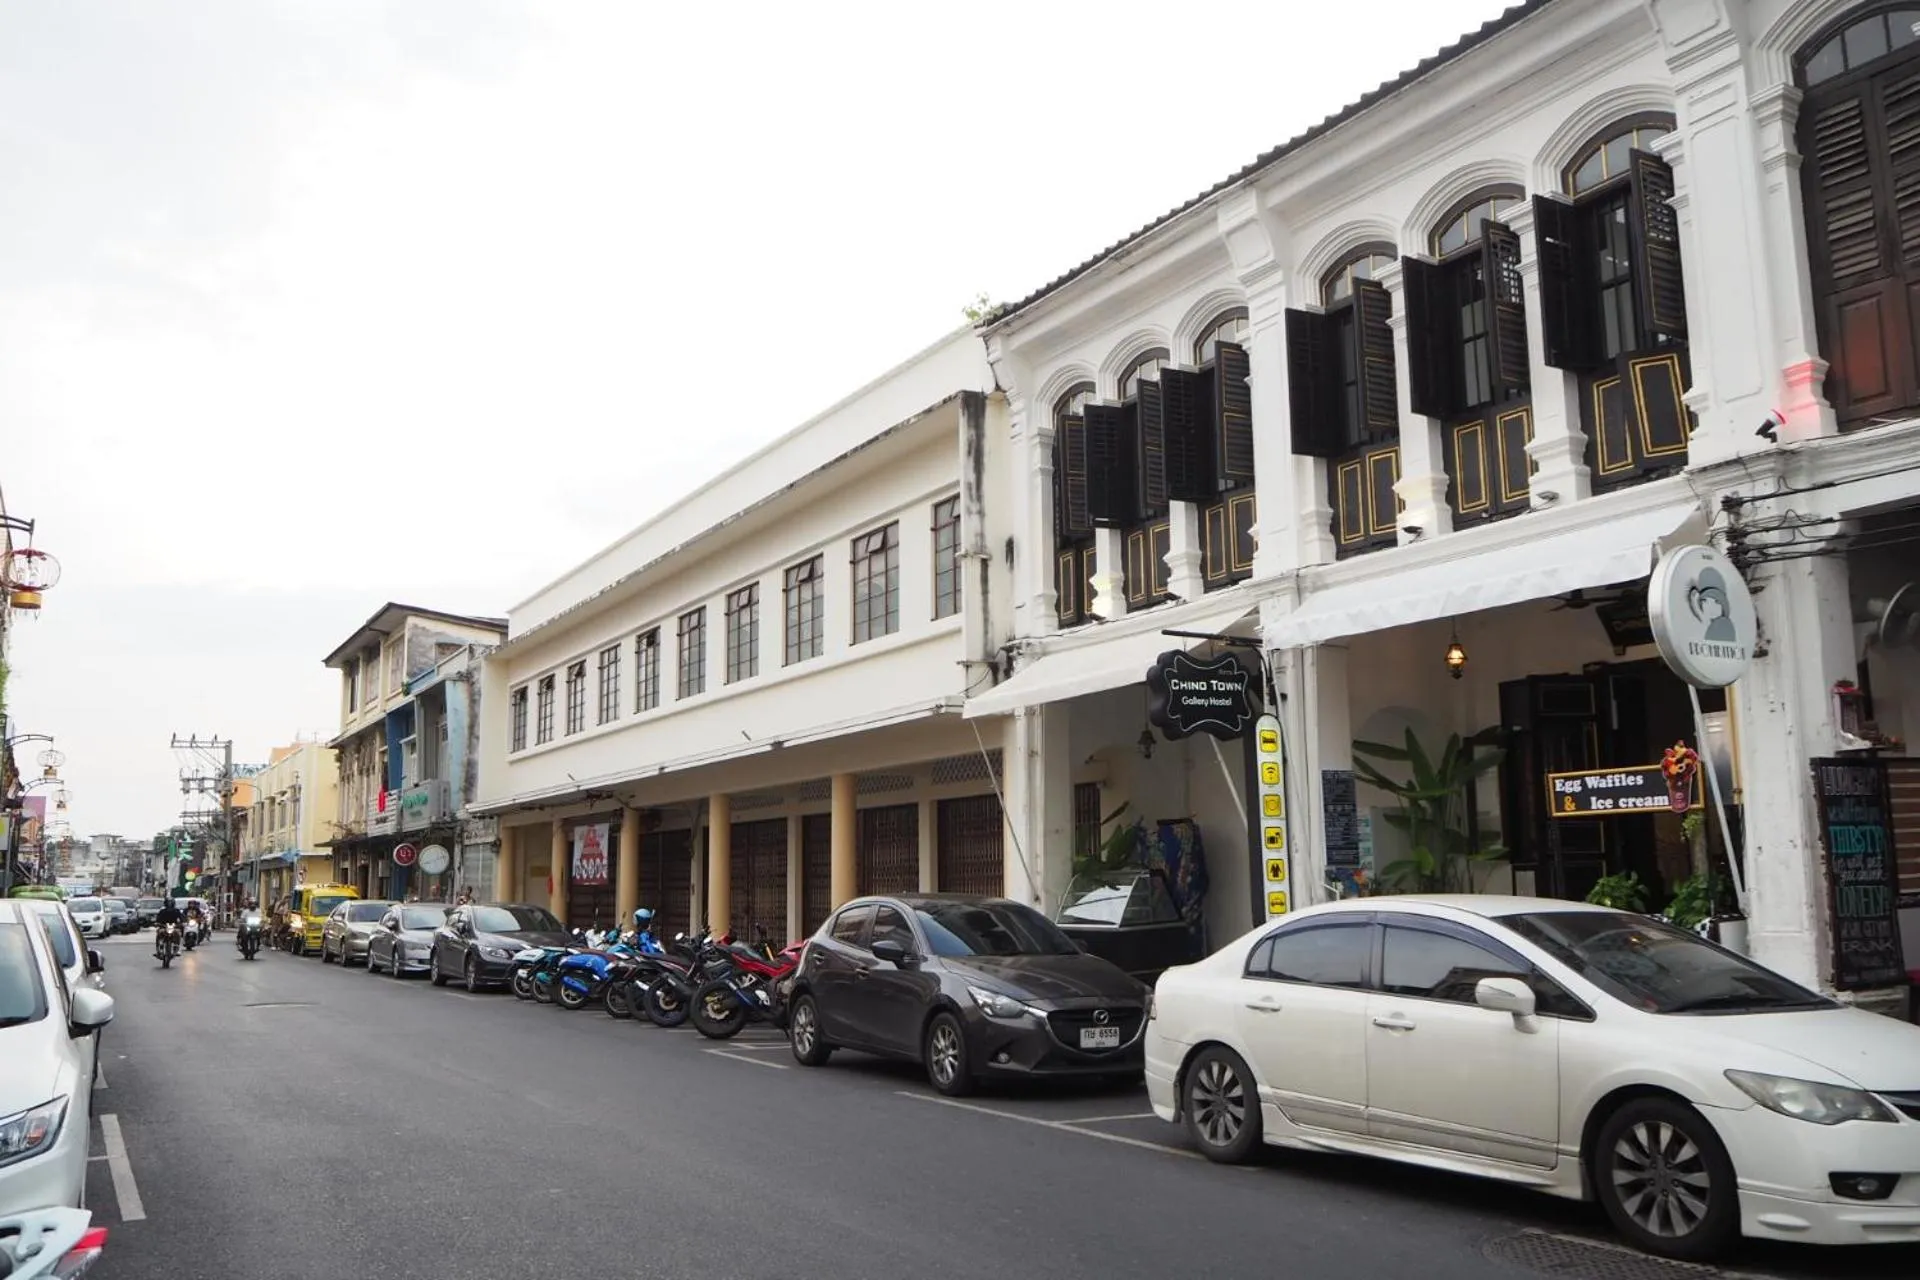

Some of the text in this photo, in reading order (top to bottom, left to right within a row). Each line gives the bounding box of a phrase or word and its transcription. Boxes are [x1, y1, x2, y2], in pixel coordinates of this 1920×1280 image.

[1170, 679, 1242, 691] CHINO TOWN
[1181, 696, 1208, 707] Gallery
[1555, 773, 1644, 793] Egg Waffles
[1564, 795, 1669, 811] & Ice cream
